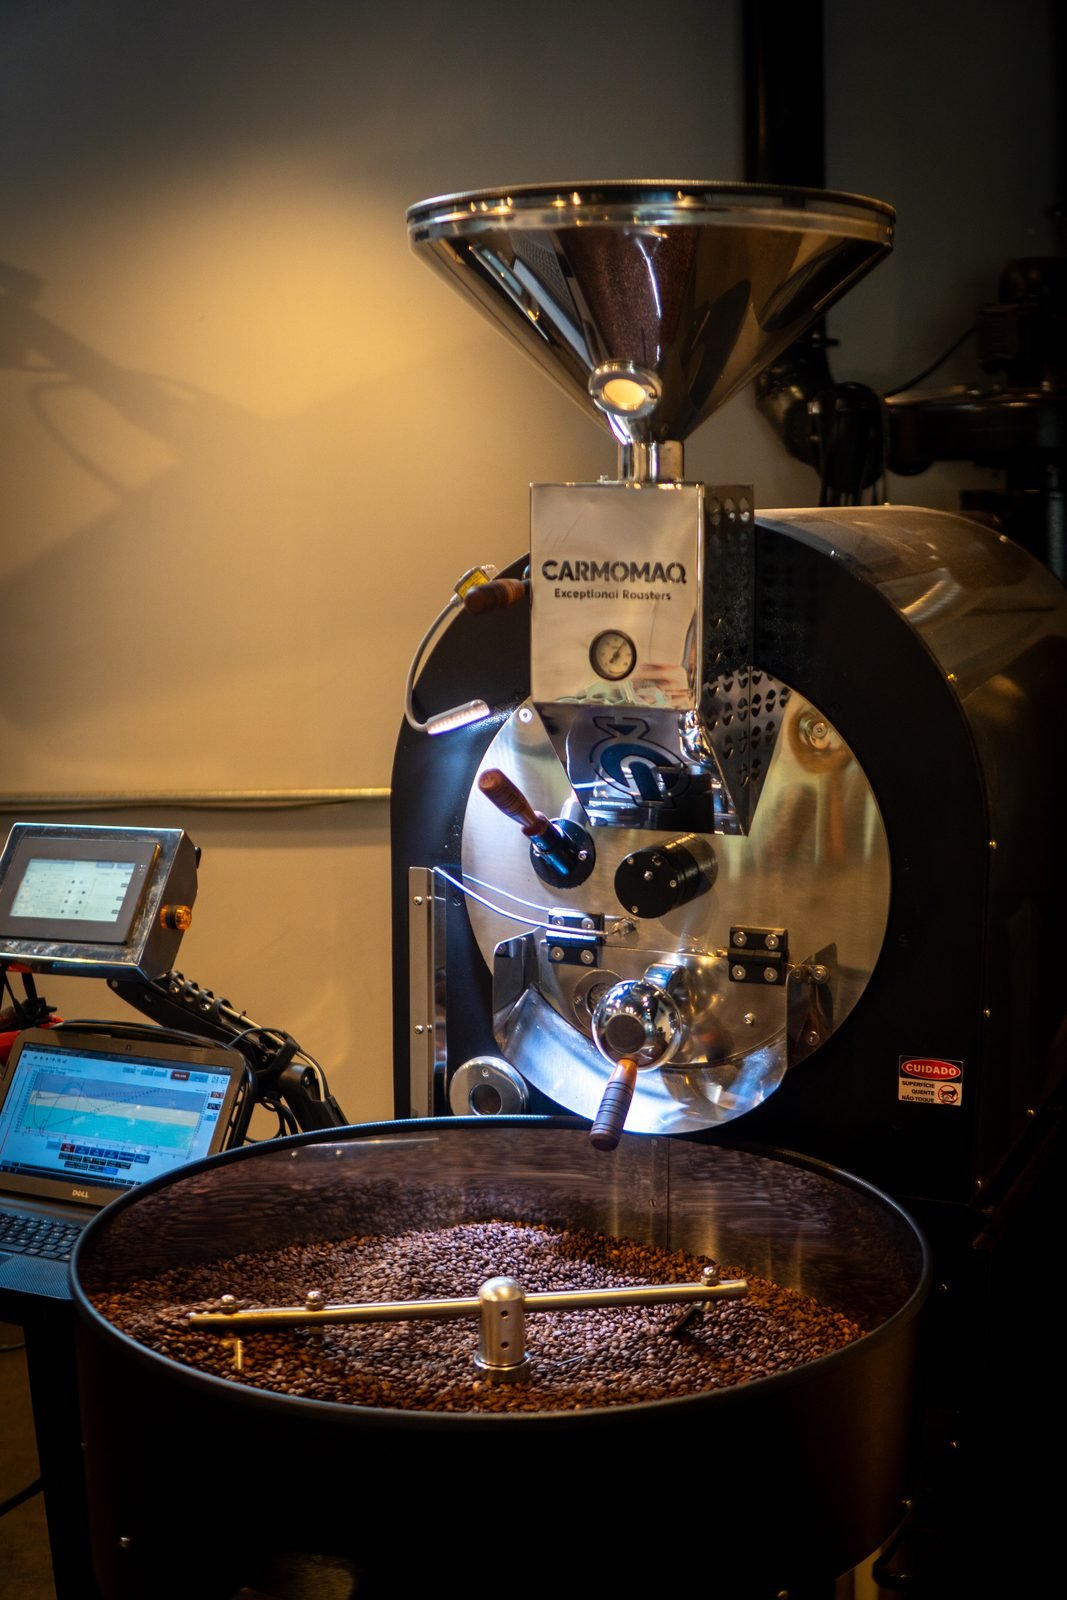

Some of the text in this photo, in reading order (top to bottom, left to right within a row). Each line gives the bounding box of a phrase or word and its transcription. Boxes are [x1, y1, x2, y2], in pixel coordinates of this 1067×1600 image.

[541, 559, 688, 585] CARMOMAQ
[554, 588, 672, 600] Exceptional Roasters
[905, 1063, 957, 1076] CUIDADO
[72, 1189, 89, 1199] DELL
